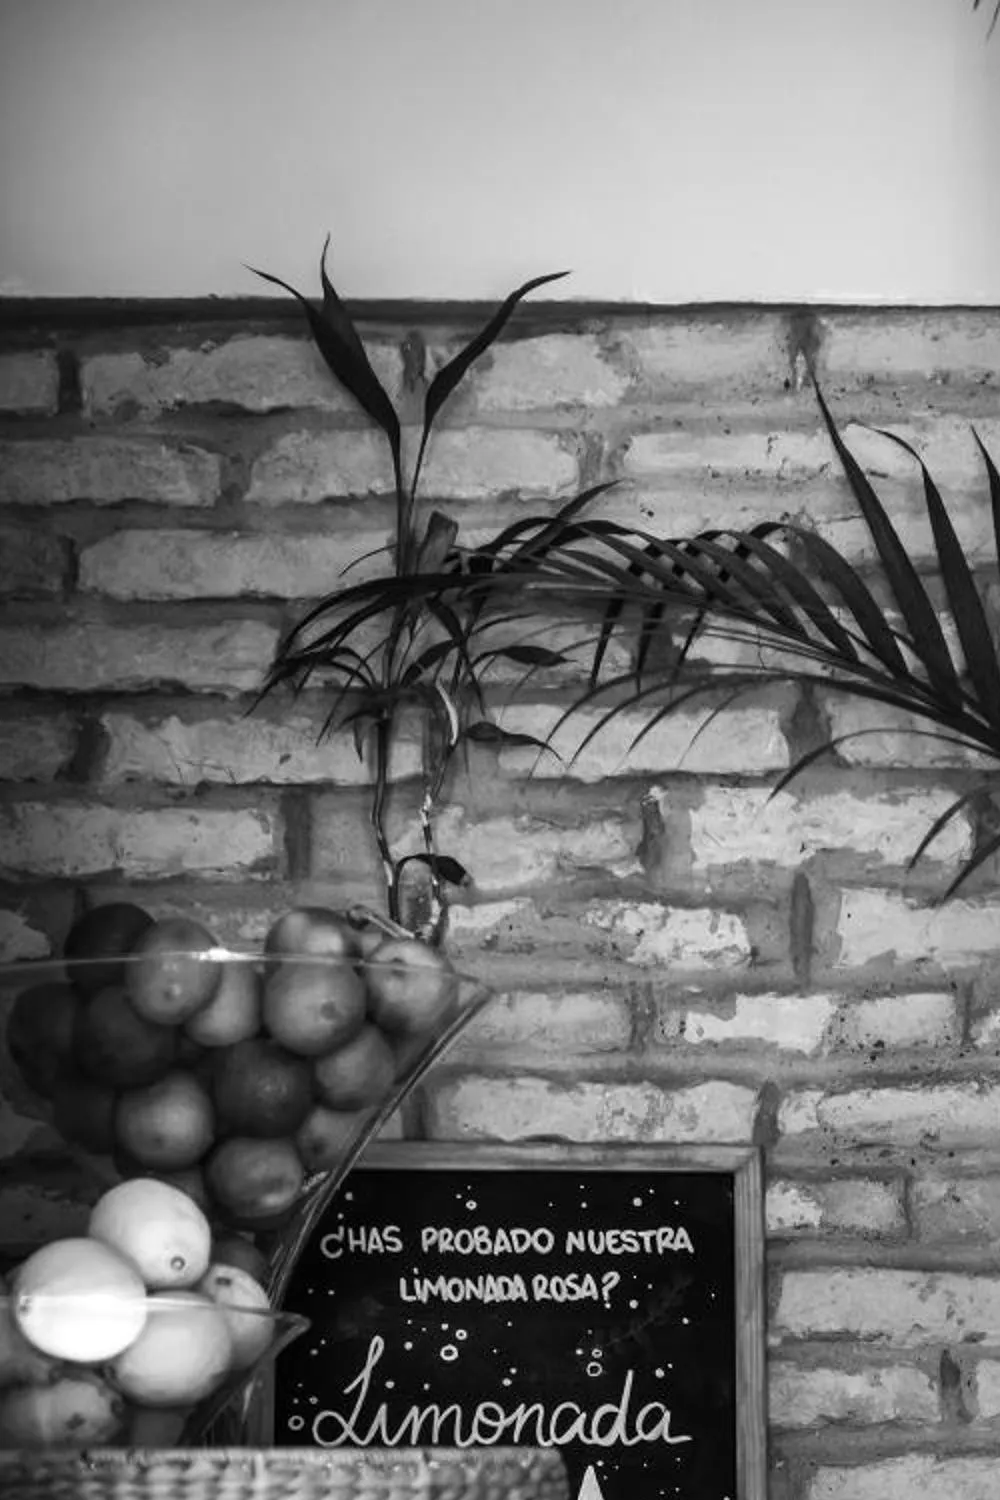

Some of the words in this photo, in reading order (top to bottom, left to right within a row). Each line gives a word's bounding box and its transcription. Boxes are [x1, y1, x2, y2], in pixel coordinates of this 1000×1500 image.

[320, 1212, 403, 1259] ¿HAS
[421, 1225, 554, 1256] PROBADO
[565, 1227, 694, 1255] NUESTRA
[532, 1271, 621, 1309] ROSA?
[312, 1335, 692, 1447] Limonada
